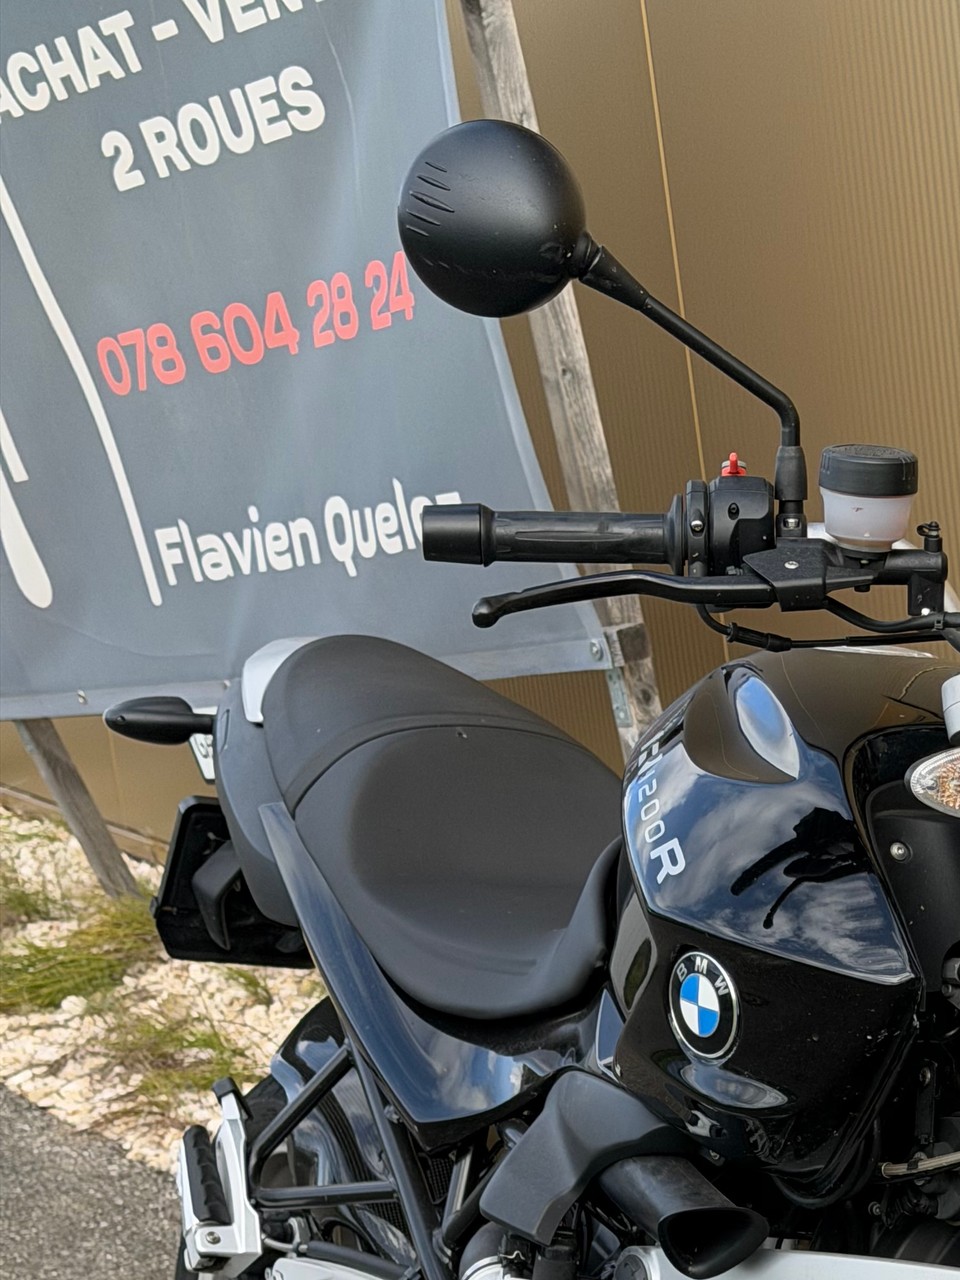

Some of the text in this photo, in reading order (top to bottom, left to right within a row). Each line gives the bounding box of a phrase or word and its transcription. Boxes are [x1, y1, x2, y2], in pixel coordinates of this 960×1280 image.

[101, 65, 326, 192] 2 ROUES
[97, 251, 414, 396] 078 604 28 24
[154, 478, 462, 586] Flavien Quelo
[676, 955, 730, 997] BMW
